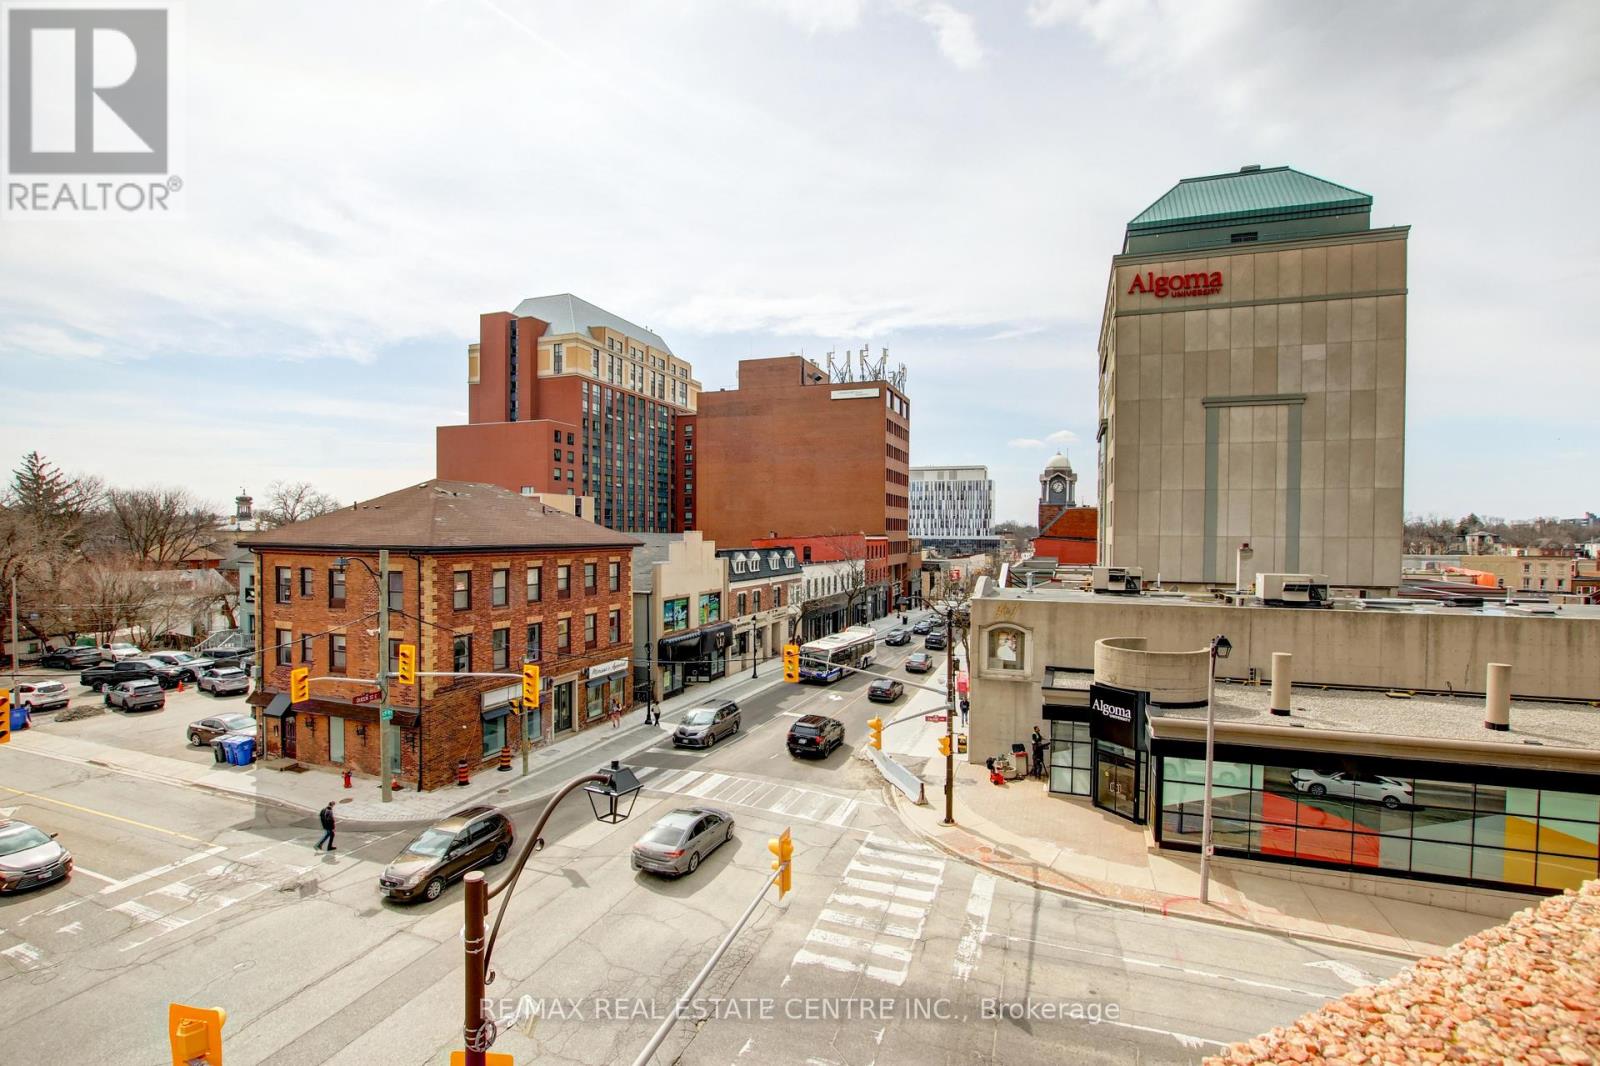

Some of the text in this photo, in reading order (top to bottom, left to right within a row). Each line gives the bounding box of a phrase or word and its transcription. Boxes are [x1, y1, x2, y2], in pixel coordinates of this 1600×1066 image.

[1128, 271, 1223, 298] Algoma
[1171, 287, 1222, 298] UNIVERSITY
[1092, 698, 1132, 718] Algoma
